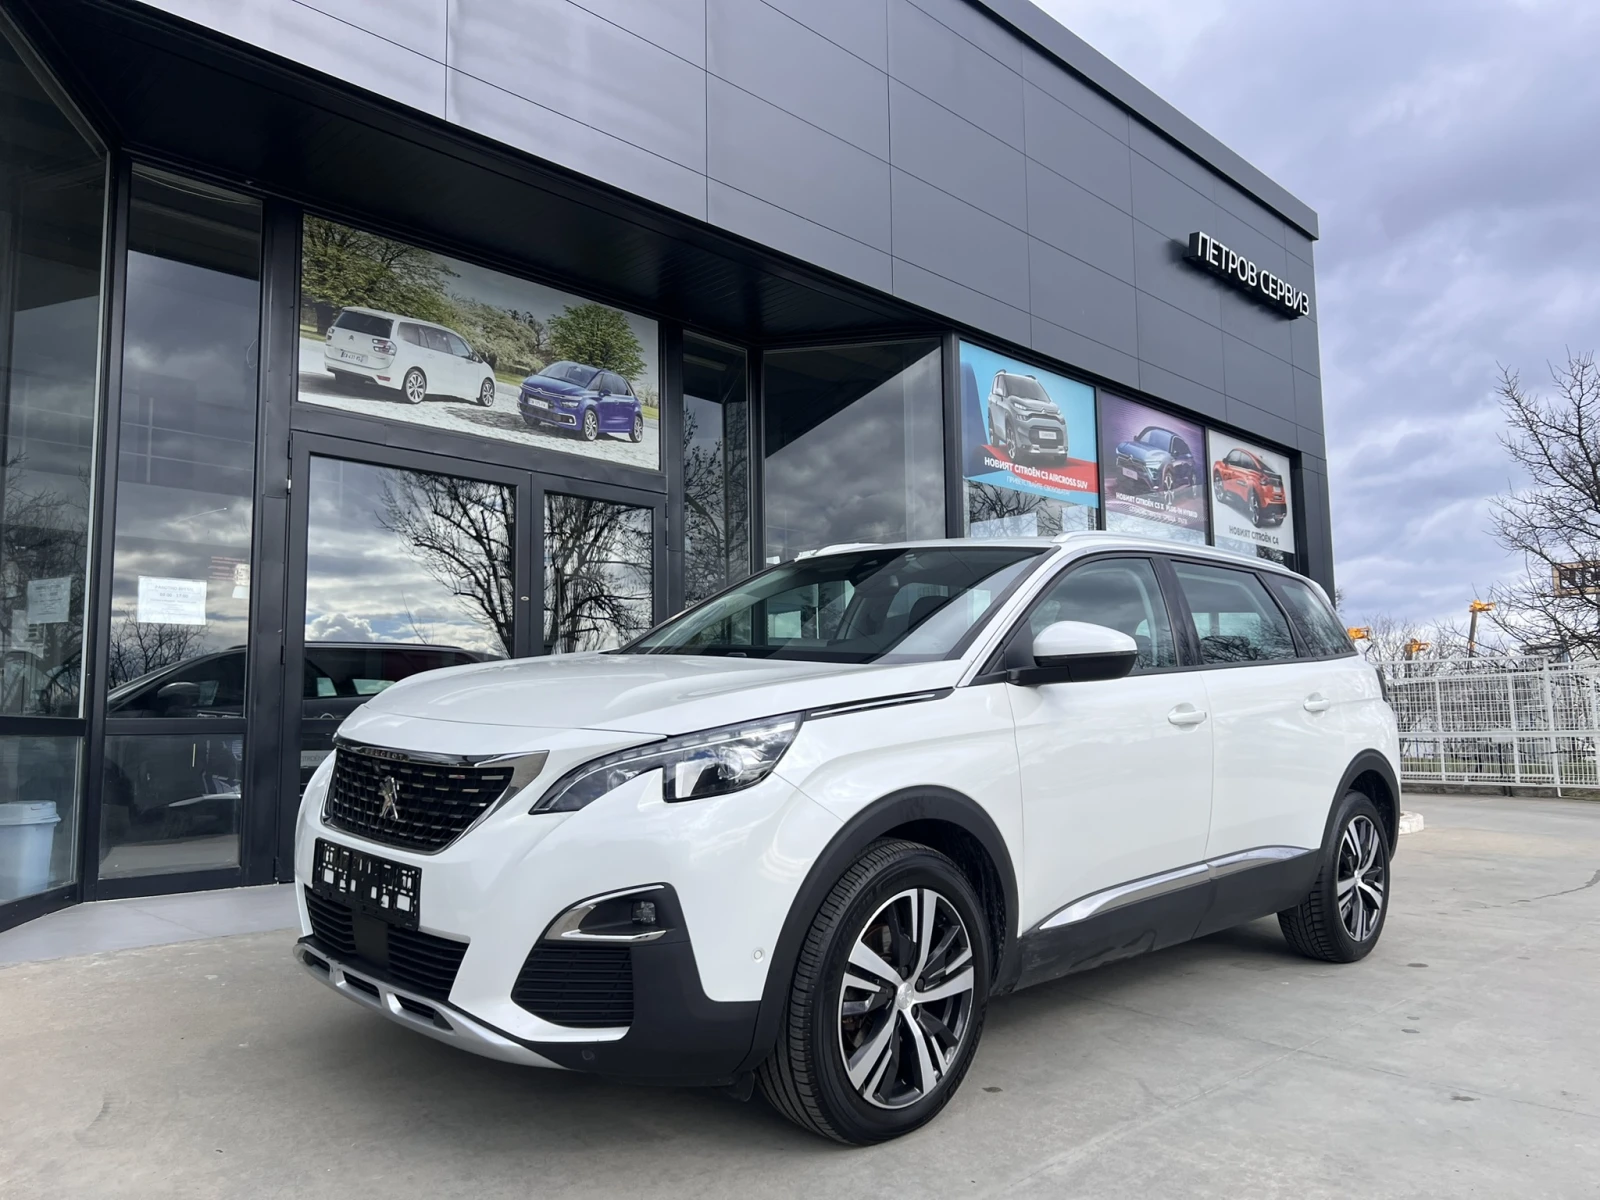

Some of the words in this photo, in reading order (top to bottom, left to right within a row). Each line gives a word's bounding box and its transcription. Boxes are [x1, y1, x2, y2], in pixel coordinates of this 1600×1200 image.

[1198, 231, 1257, 286] ПЕТРОВ
[1260, 270, 1309, 316] СЕРВИЗ
[984, 456, 1013, 472] НОВИЯТ
[1014, 464, 1041, 478] CITROËN
[1041, 471, 1049, 480] C3
[1049, 472, 1077, 487] AIRCROSS
[1077, 479, 1088, 490] SUV
[1116, 492, 1135, 503] НОВИЯТ
[1136, 497, 1154, 507] CITROËN
[1228, 525, 1250, 538] НОВИЯТ
[1251, 531, 1271, 543] CITROËN
